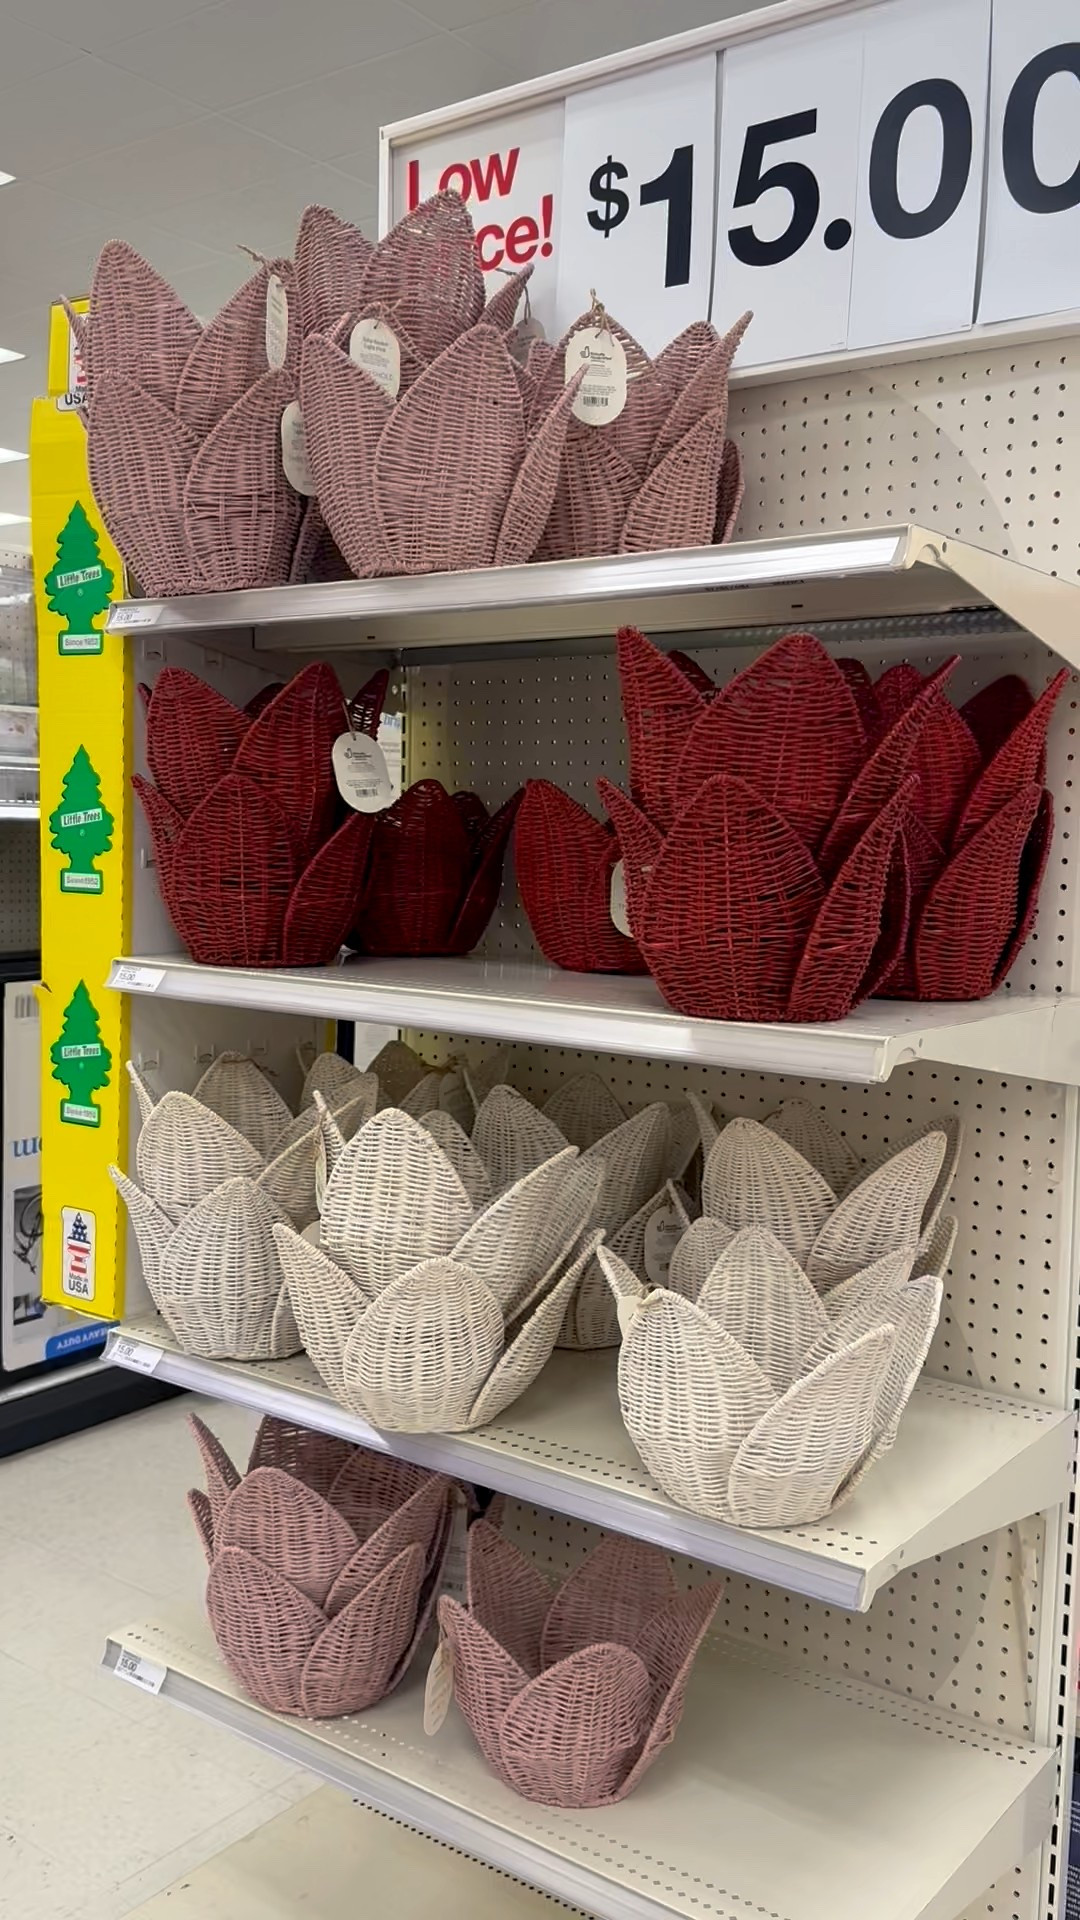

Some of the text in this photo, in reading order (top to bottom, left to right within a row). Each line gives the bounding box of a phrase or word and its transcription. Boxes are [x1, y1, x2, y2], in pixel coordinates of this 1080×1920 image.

[475, 193, 553, 271] ce!
[60, 568, 99, 587] Little Trees
[63, 810, 101, 827] Little Trees
[63, 1044, 100, 1059] Little Trees
[69, 1280, 89, 1295] USA
[57, 1335, 80, 1349] DUTY
[120, 1657, 138, 1672] 15.00
